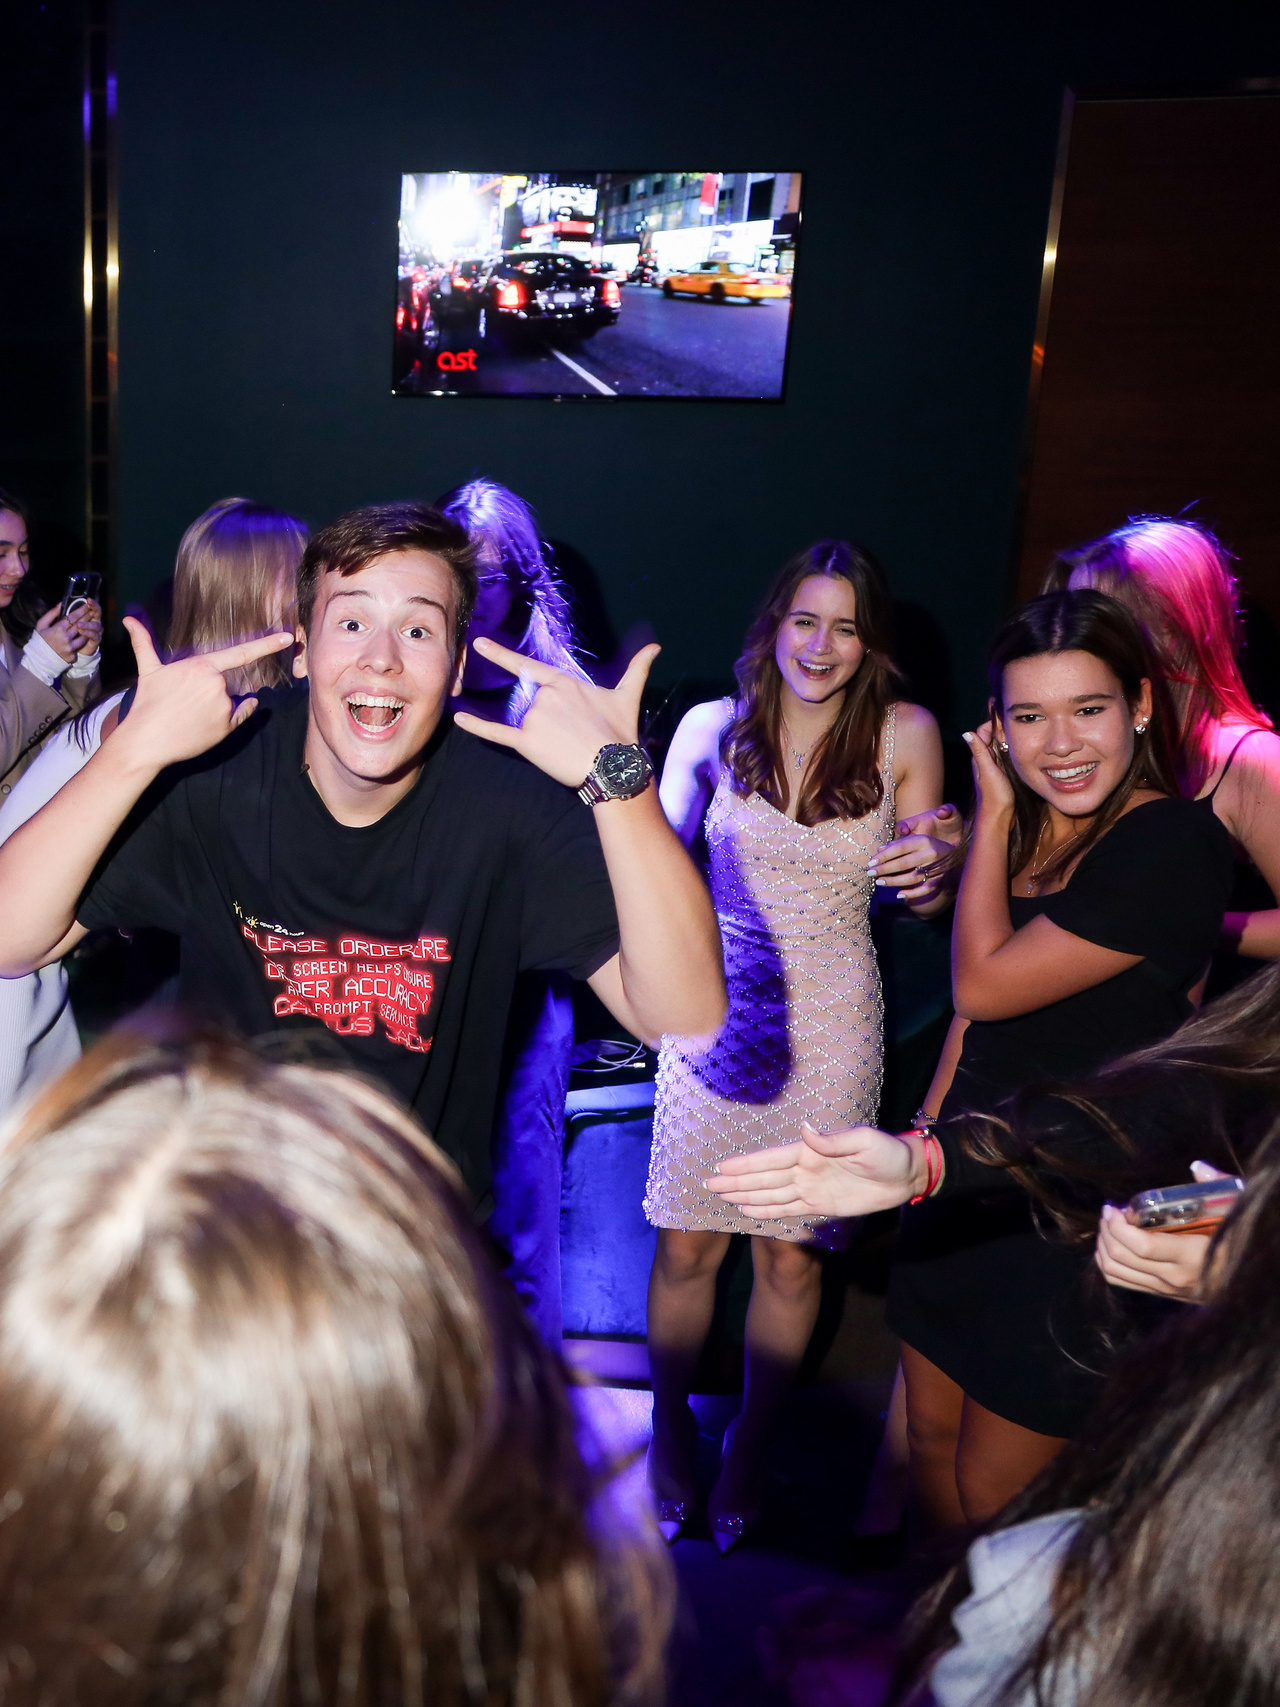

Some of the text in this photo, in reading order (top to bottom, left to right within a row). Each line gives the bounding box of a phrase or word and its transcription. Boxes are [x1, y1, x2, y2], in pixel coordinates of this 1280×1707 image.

[437, 348, 477, 371] ast
[242, 926, 326, 952] PLEASE
[259, 921, 275, 930] open
[274, 925, 288, 935] 24
[293, 961, 347, 977] SCREEN
[356, 963, 402, 976] HELPS
[403, 966, 432, 988] ENSURE
[344, 978, 428, 1012] ACCURACY
[314, 1001, 415, 1029] PROMPT SERVICE
